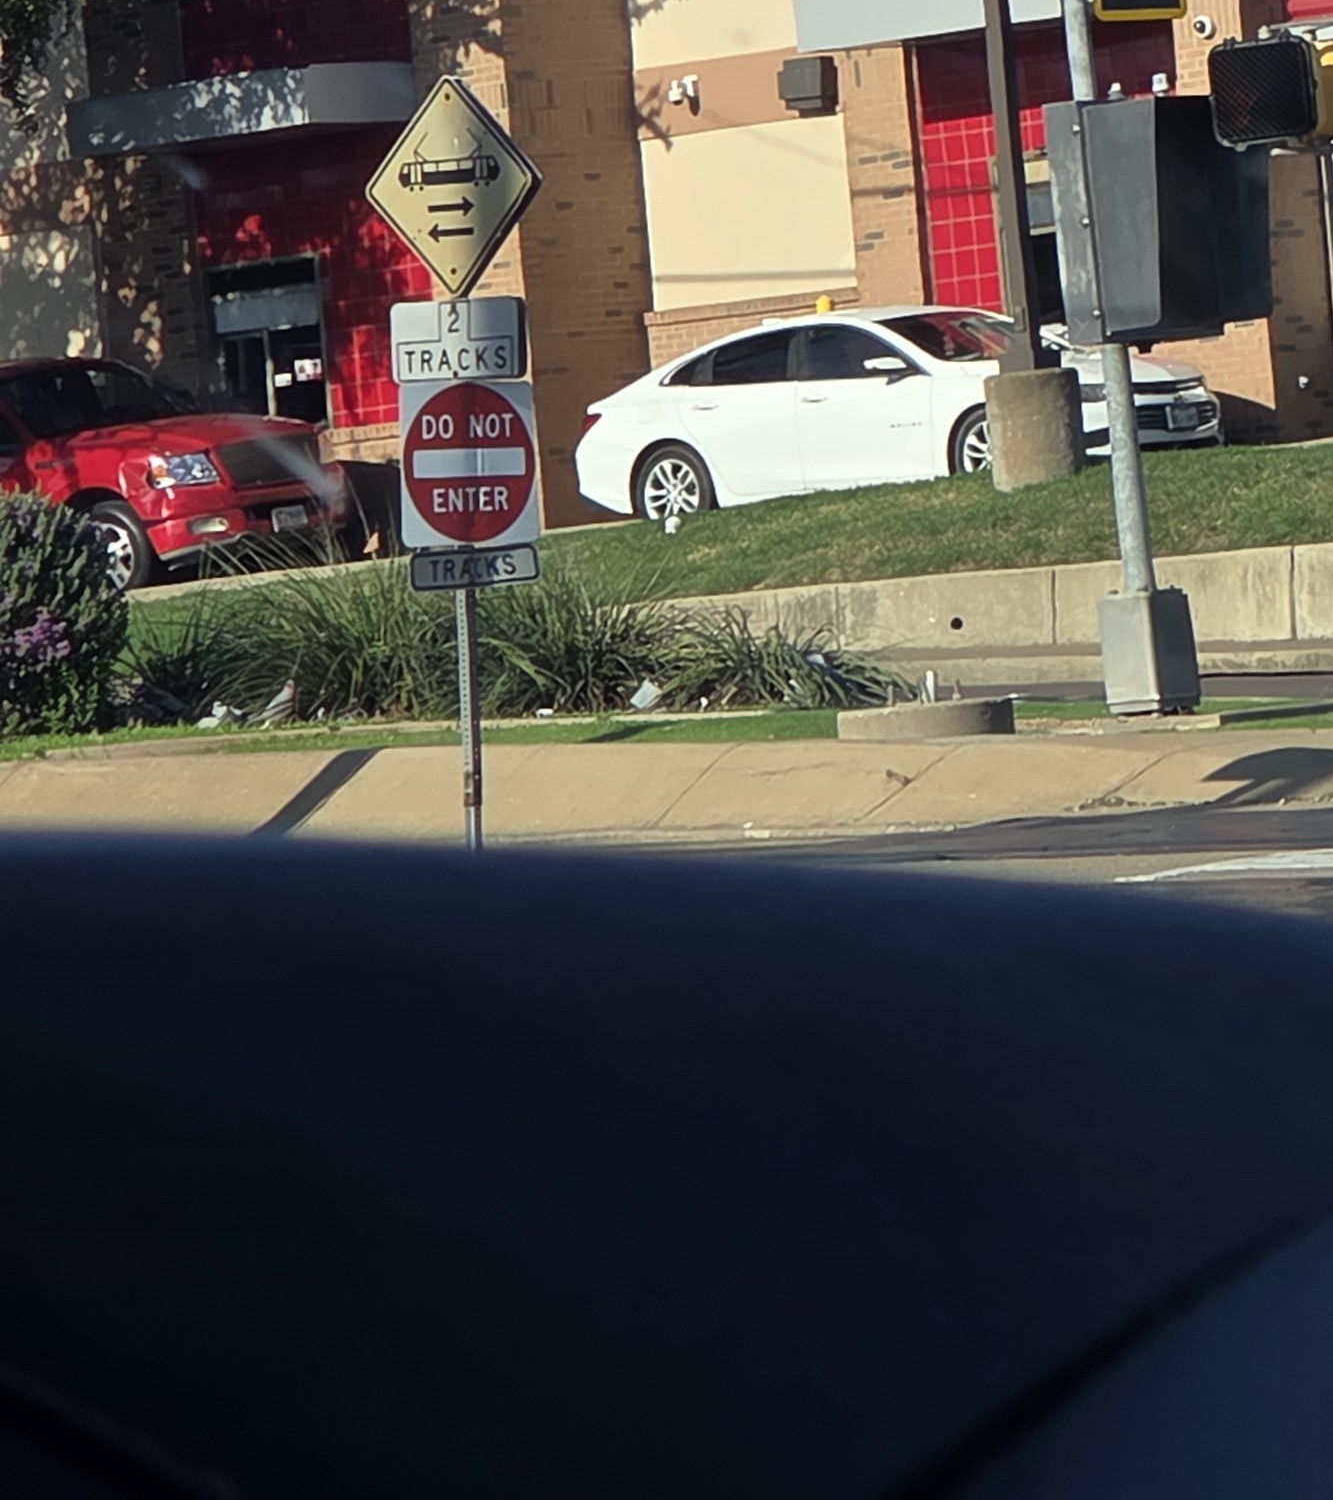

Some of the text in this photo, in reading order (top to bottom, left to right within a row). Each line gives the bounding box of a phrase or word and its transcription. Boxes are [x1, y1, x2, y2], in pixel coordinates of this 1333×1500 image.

[447, 308, 460, 333] 2
[404, 345, 508, 374] TRACKS
[421, 413, 514, 440] DO NOT
[432, 486, 509, 513] ENTER
[429, 553, 517, 583] TRACKS
